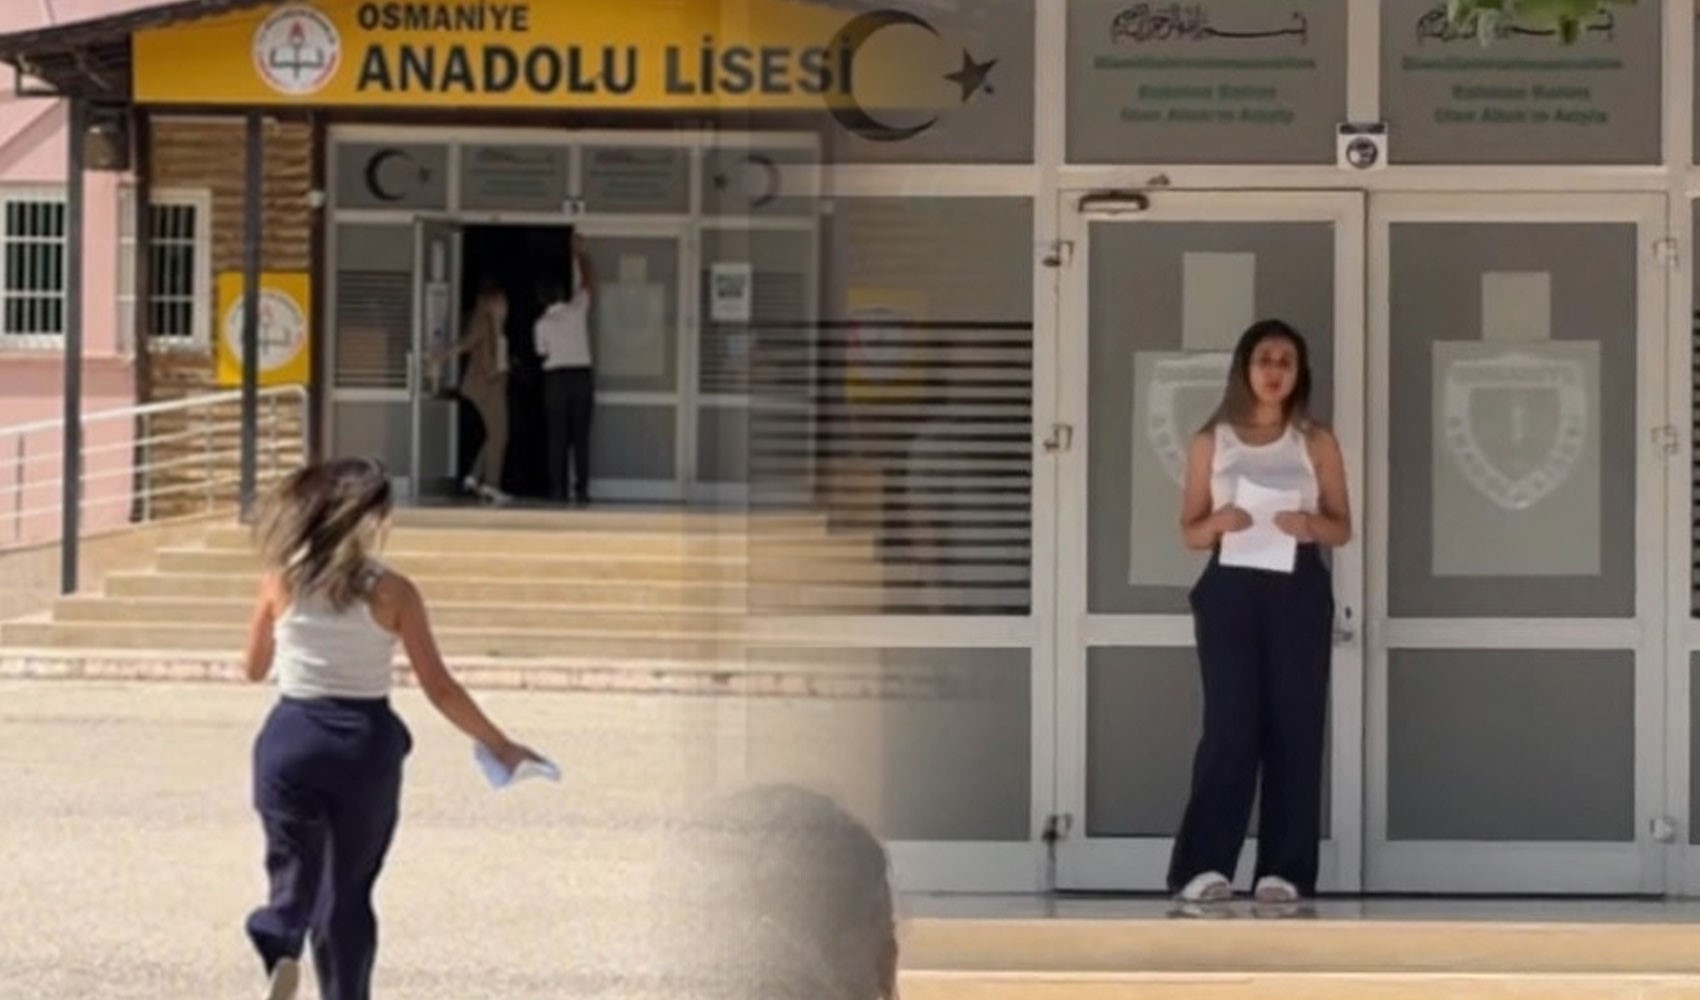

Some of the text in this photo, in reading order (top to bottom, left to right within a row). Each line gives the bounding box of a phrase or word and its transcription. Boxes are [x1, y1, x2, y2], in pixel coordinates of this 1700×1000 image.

[357, 1, 529, 32] OSMANİYE
[356, 43, 637, 94] ANADOLU
[664, 36, 854, 95] LİSESİ
